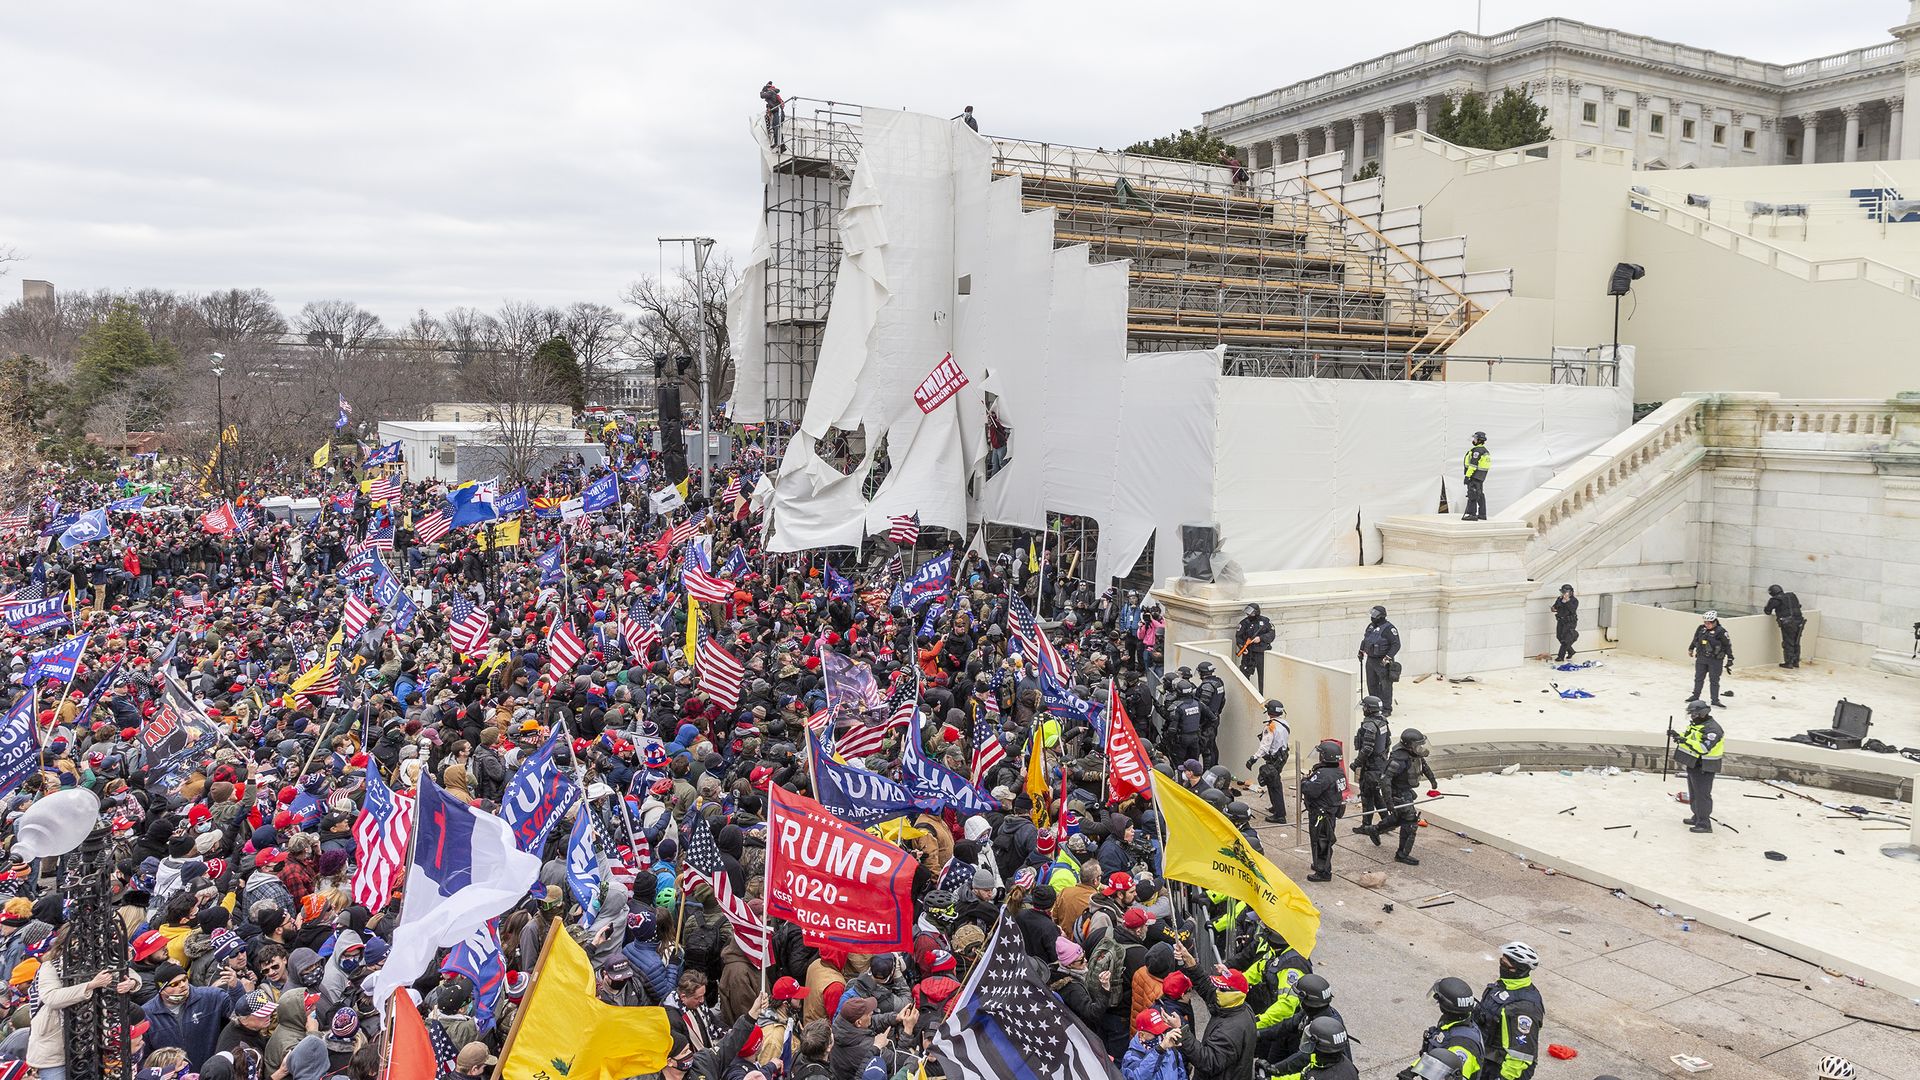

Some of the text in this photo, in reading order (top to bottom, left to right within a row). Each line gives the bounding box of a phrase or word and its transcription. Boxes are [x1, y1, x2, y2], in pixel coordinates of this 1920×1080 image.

[1212, 860, 1235, 877] DONT
[1262, 889, 1279, 905] ME
[835, 917, 891, 935] GREAT!
